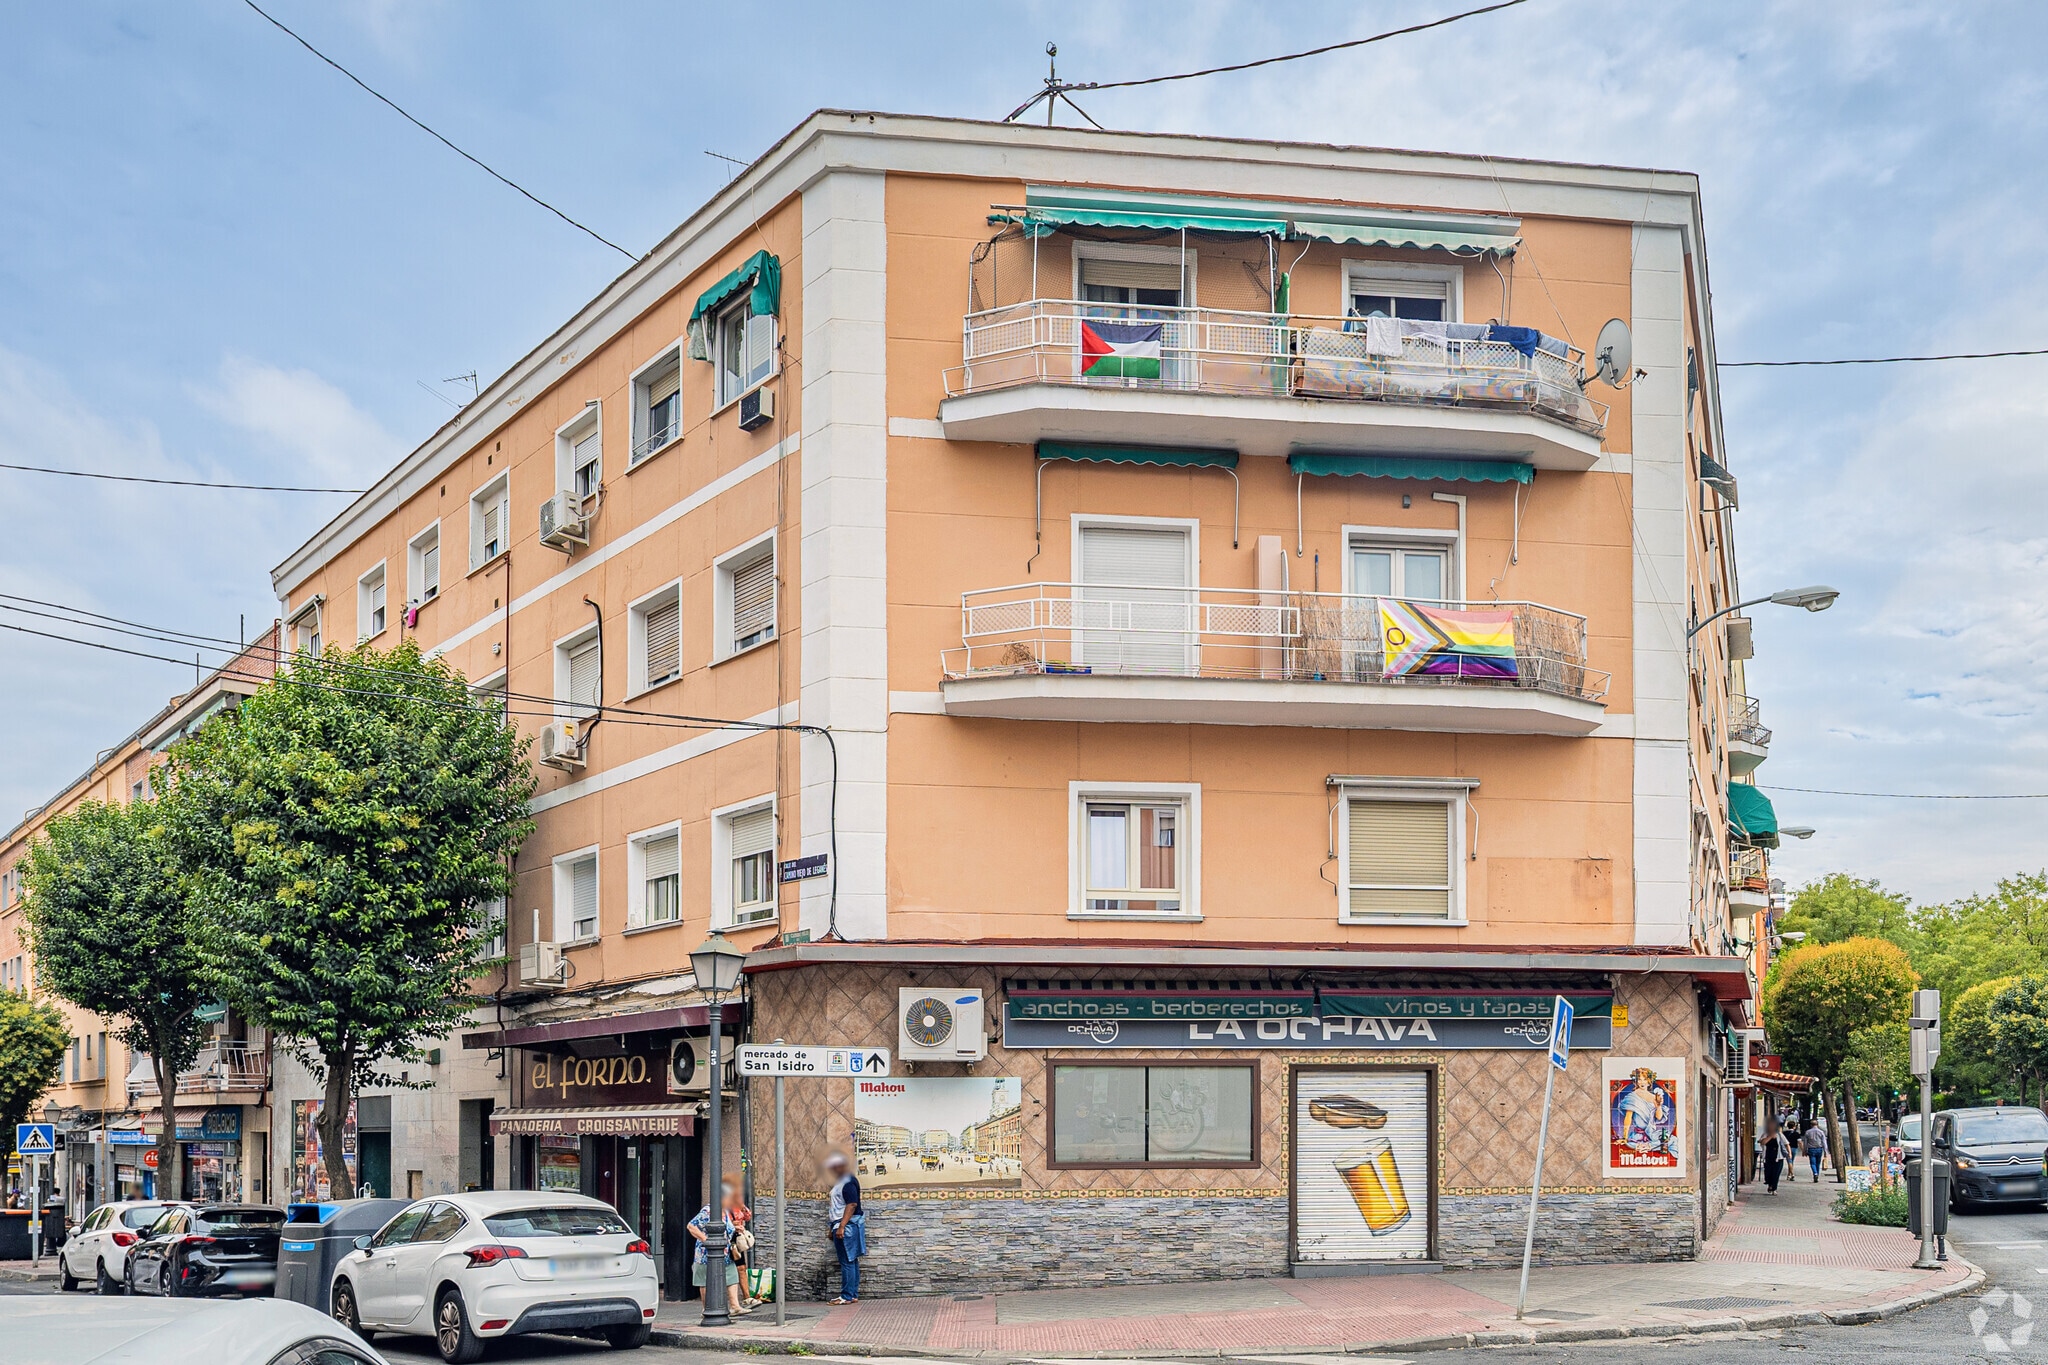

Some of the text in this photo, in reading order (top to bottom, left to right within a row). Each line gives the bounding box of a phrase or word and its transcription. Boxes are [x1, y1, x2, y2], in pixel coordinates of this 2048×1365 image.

[807, 867, 812, 876] DE
[813, 862, 827, 875] LEGANÉ
[1021, 1000, 1129, 1015] anchoas
[1151, 1000, 1303, 1016] berberechos
[1385, 998, 1551, 1017] vinos y tapas
[1067, 1025, 1114, 1033] OCHAVA
[1189, 1017, 1438, 1041] LA OCHAVA
[1503, 1026, 1548, 1034] OCHAVA
[744, 1050, 807, 1059] mercado de
[744, 1060, 815, 1072] San Isidro
[859, 1082, 906, 1093] Mahou
[500, 1117, 679, 1132] PANADERIA CROISSANTERIE
[1620, 1153, 1669, 1166] Mahou
